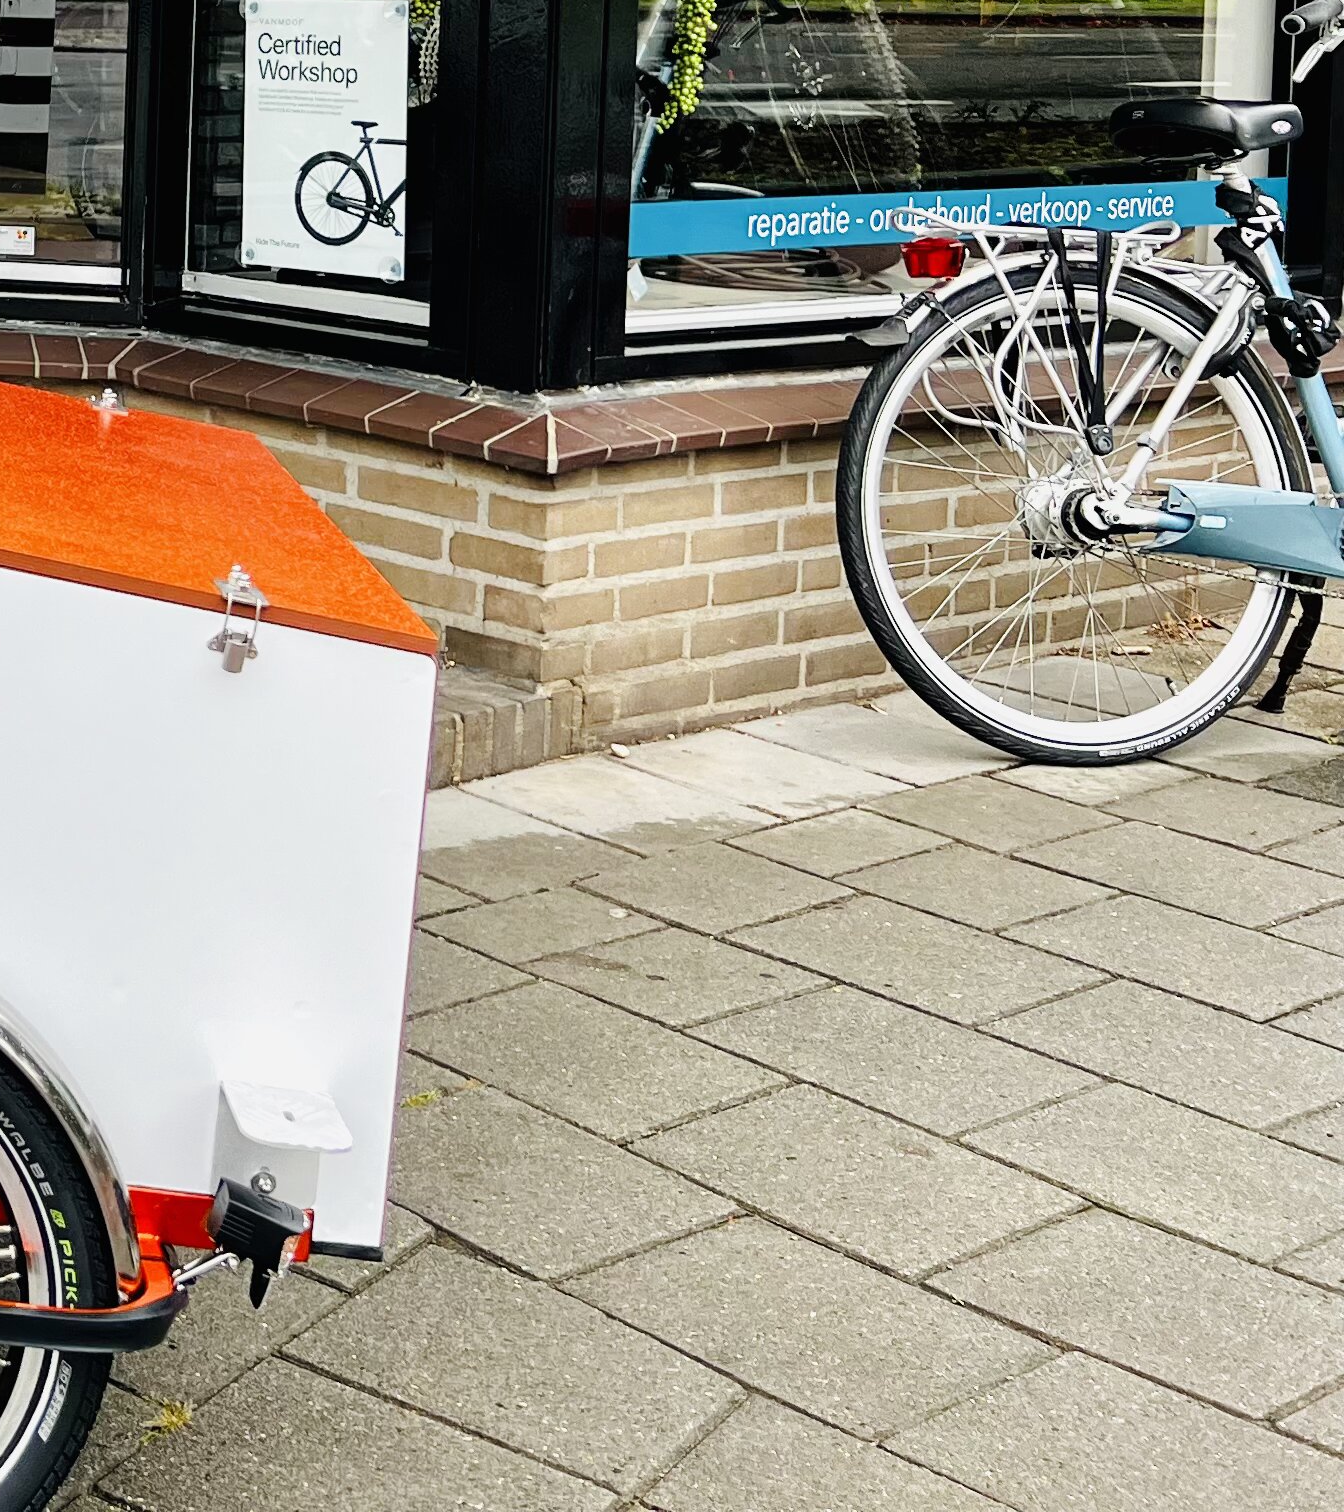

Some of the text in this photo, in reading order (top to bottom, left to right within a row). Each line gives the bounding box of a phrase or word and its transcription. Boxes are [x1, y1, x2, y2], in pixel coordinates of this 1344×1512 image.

[257, 33, 341, 56] Certified
[257, 59, 358, 88] Workshop
[747, 202, 850, 246] reparatie
[1008, 194, 1092, 227] verkoop
[1107, 188, 1175, 219] service
[59, 1239, 81, 1309] PICK-
